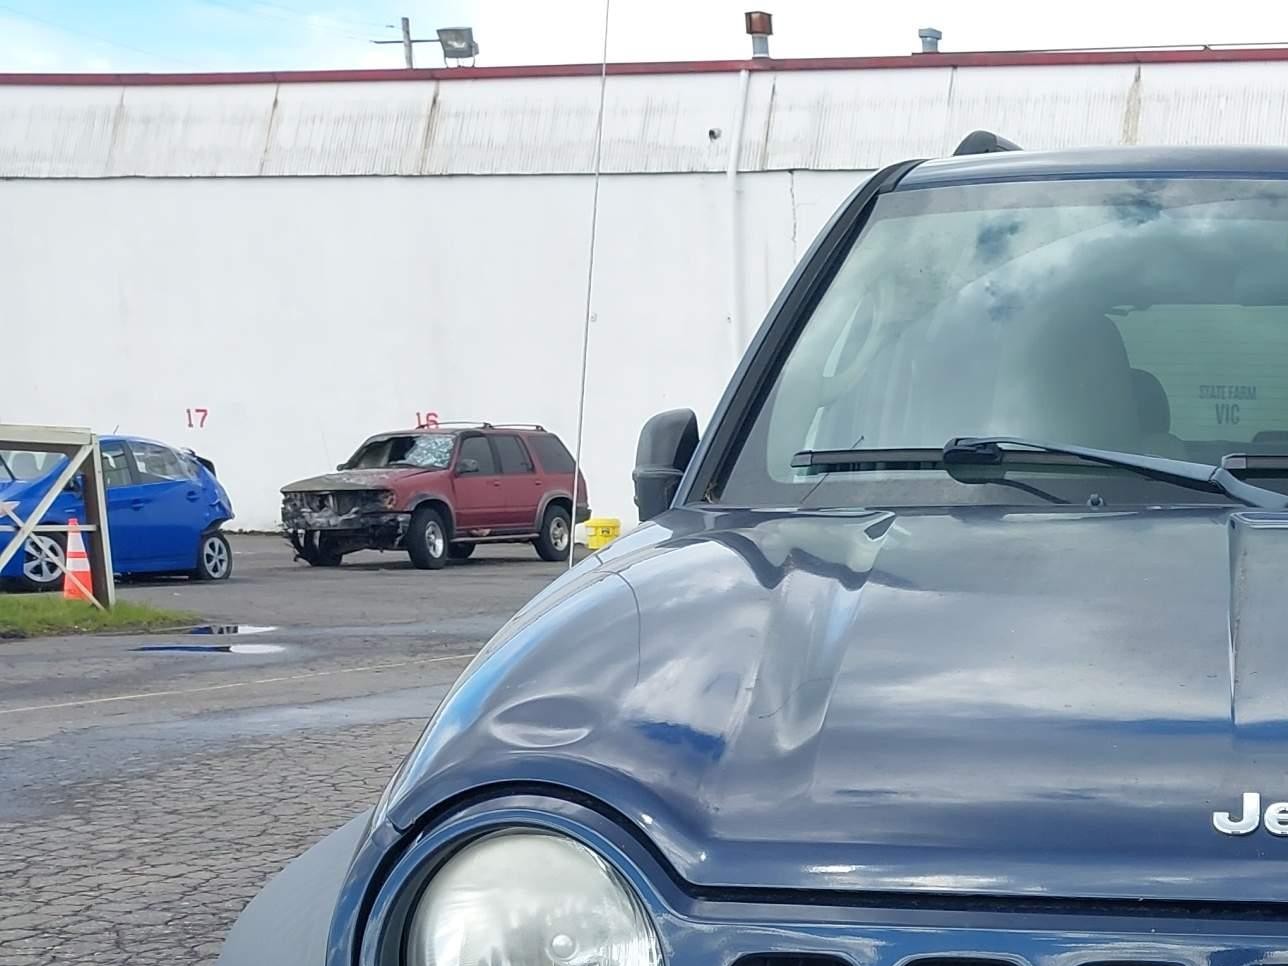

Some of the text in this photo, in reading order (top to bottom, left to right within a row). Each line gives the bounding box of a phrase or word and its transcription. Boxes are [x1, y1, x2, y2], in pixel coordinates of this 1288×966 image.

[186, 408, 208, 428] 17
[416, 412, 438, 429] 16
[1215, 403, 1240, 425] VIC
